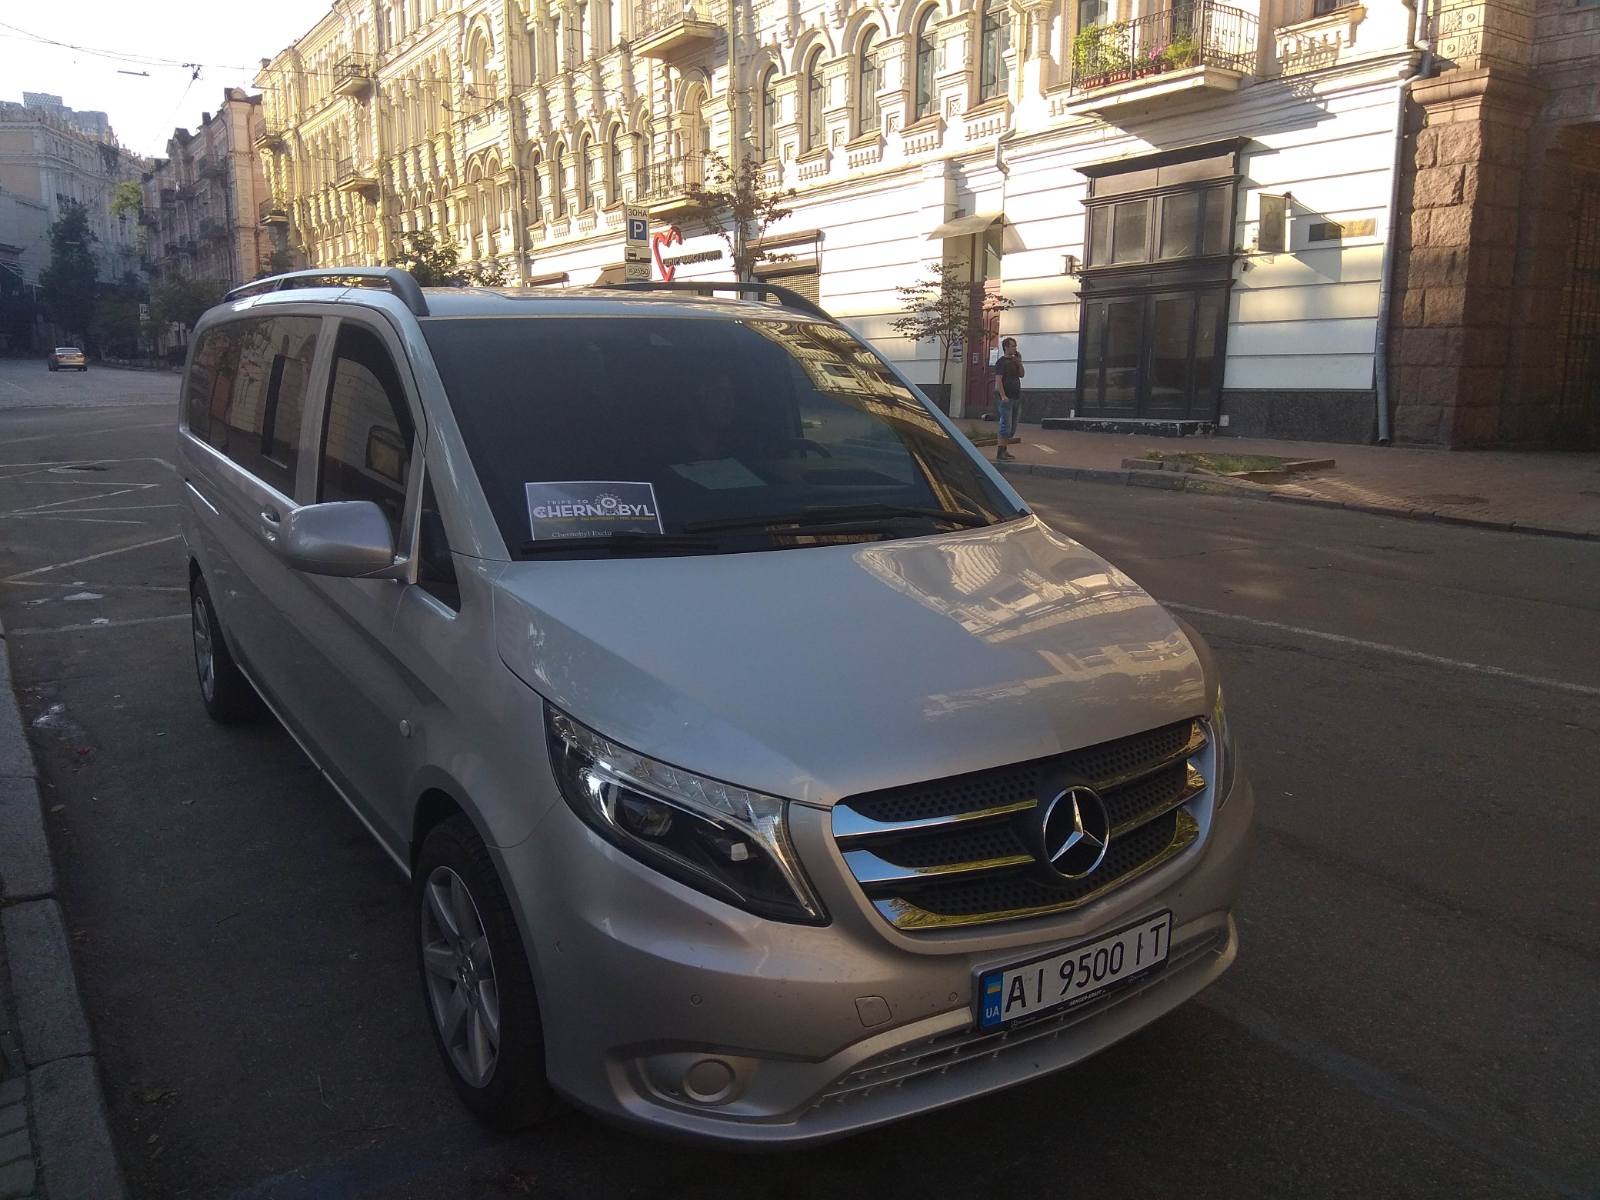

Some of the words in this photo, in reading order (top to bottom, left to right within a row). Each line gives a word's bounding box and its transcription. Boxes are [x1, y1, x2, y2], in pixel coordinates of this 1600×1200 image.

[628, 208, 648, 217] ЗОНА
[633, 221, 644, 239] P
[533, 497, 655, 518] CHERNOBYL
[1005, 968, 1044, 1013] AI
[1059, 941, 1125, 996] 9500
[1136, 922, 1167, 966] IT
[985, 1004, 1000, 1019] UA
